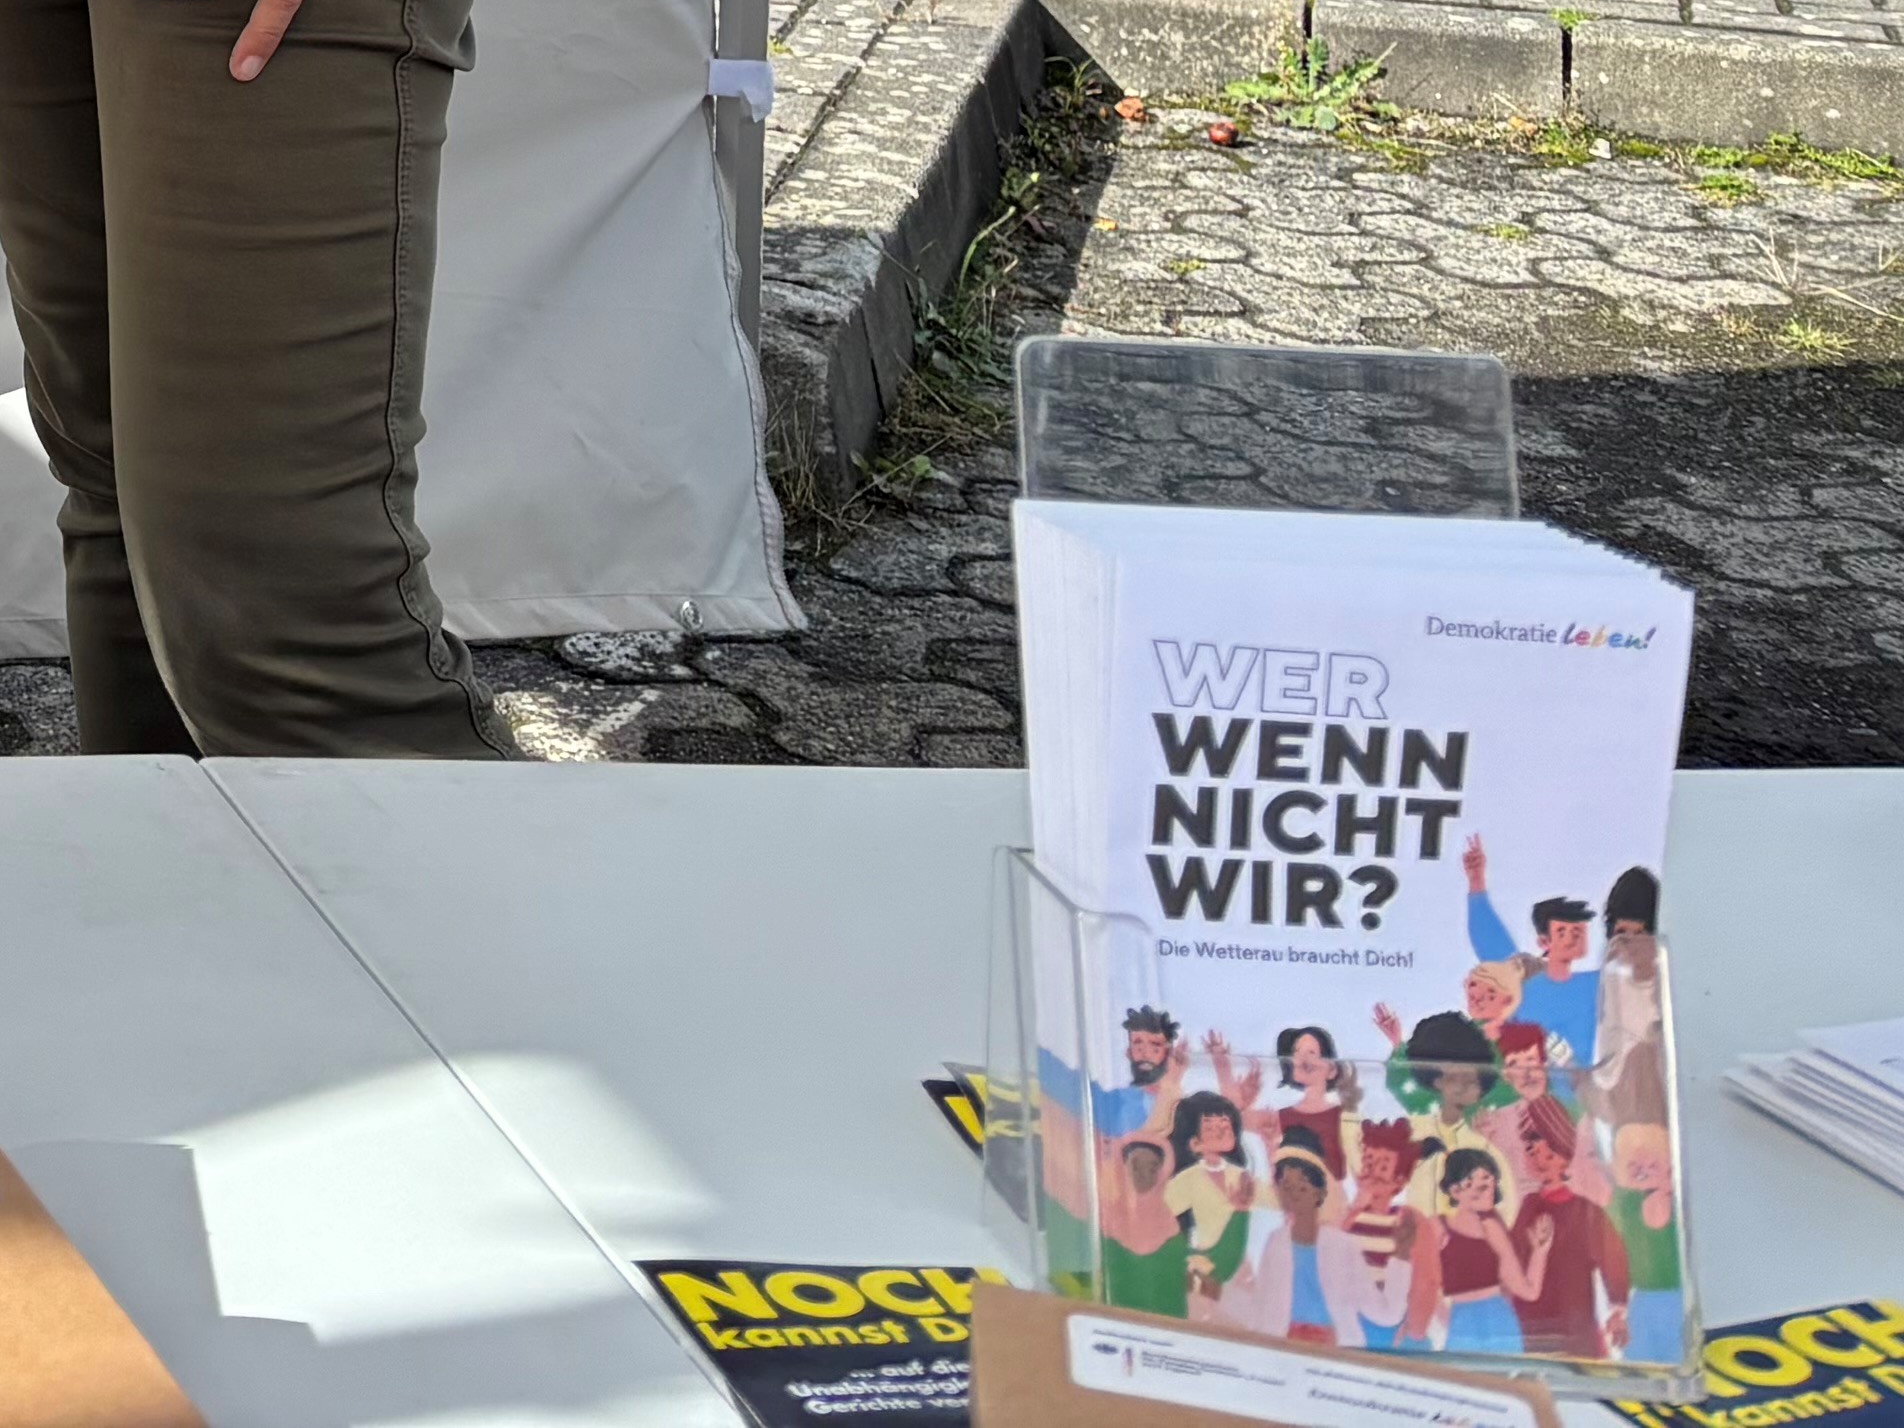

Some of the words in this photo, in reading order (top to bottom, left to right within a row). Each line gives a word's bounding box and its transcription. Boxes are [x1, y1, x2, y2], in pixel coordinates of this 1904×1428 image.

[1425, 615, 1557, 644] Demokratie
[1152, 639, 1390, 721] WER
[1151, 712, 1470, 792] WENN
[1151, 783, 1462, 861] NICHT
[1145, 853, 1400, 931] WIR?
[1157, 938, 1191, 958] Die
[1193, 941, 1284, 962] Wetterau
[1287, 945, 1360, 966] braucht
[1365, 949, 1414, 969] Dich!
[695, 1318, 911, 1351] kannst
